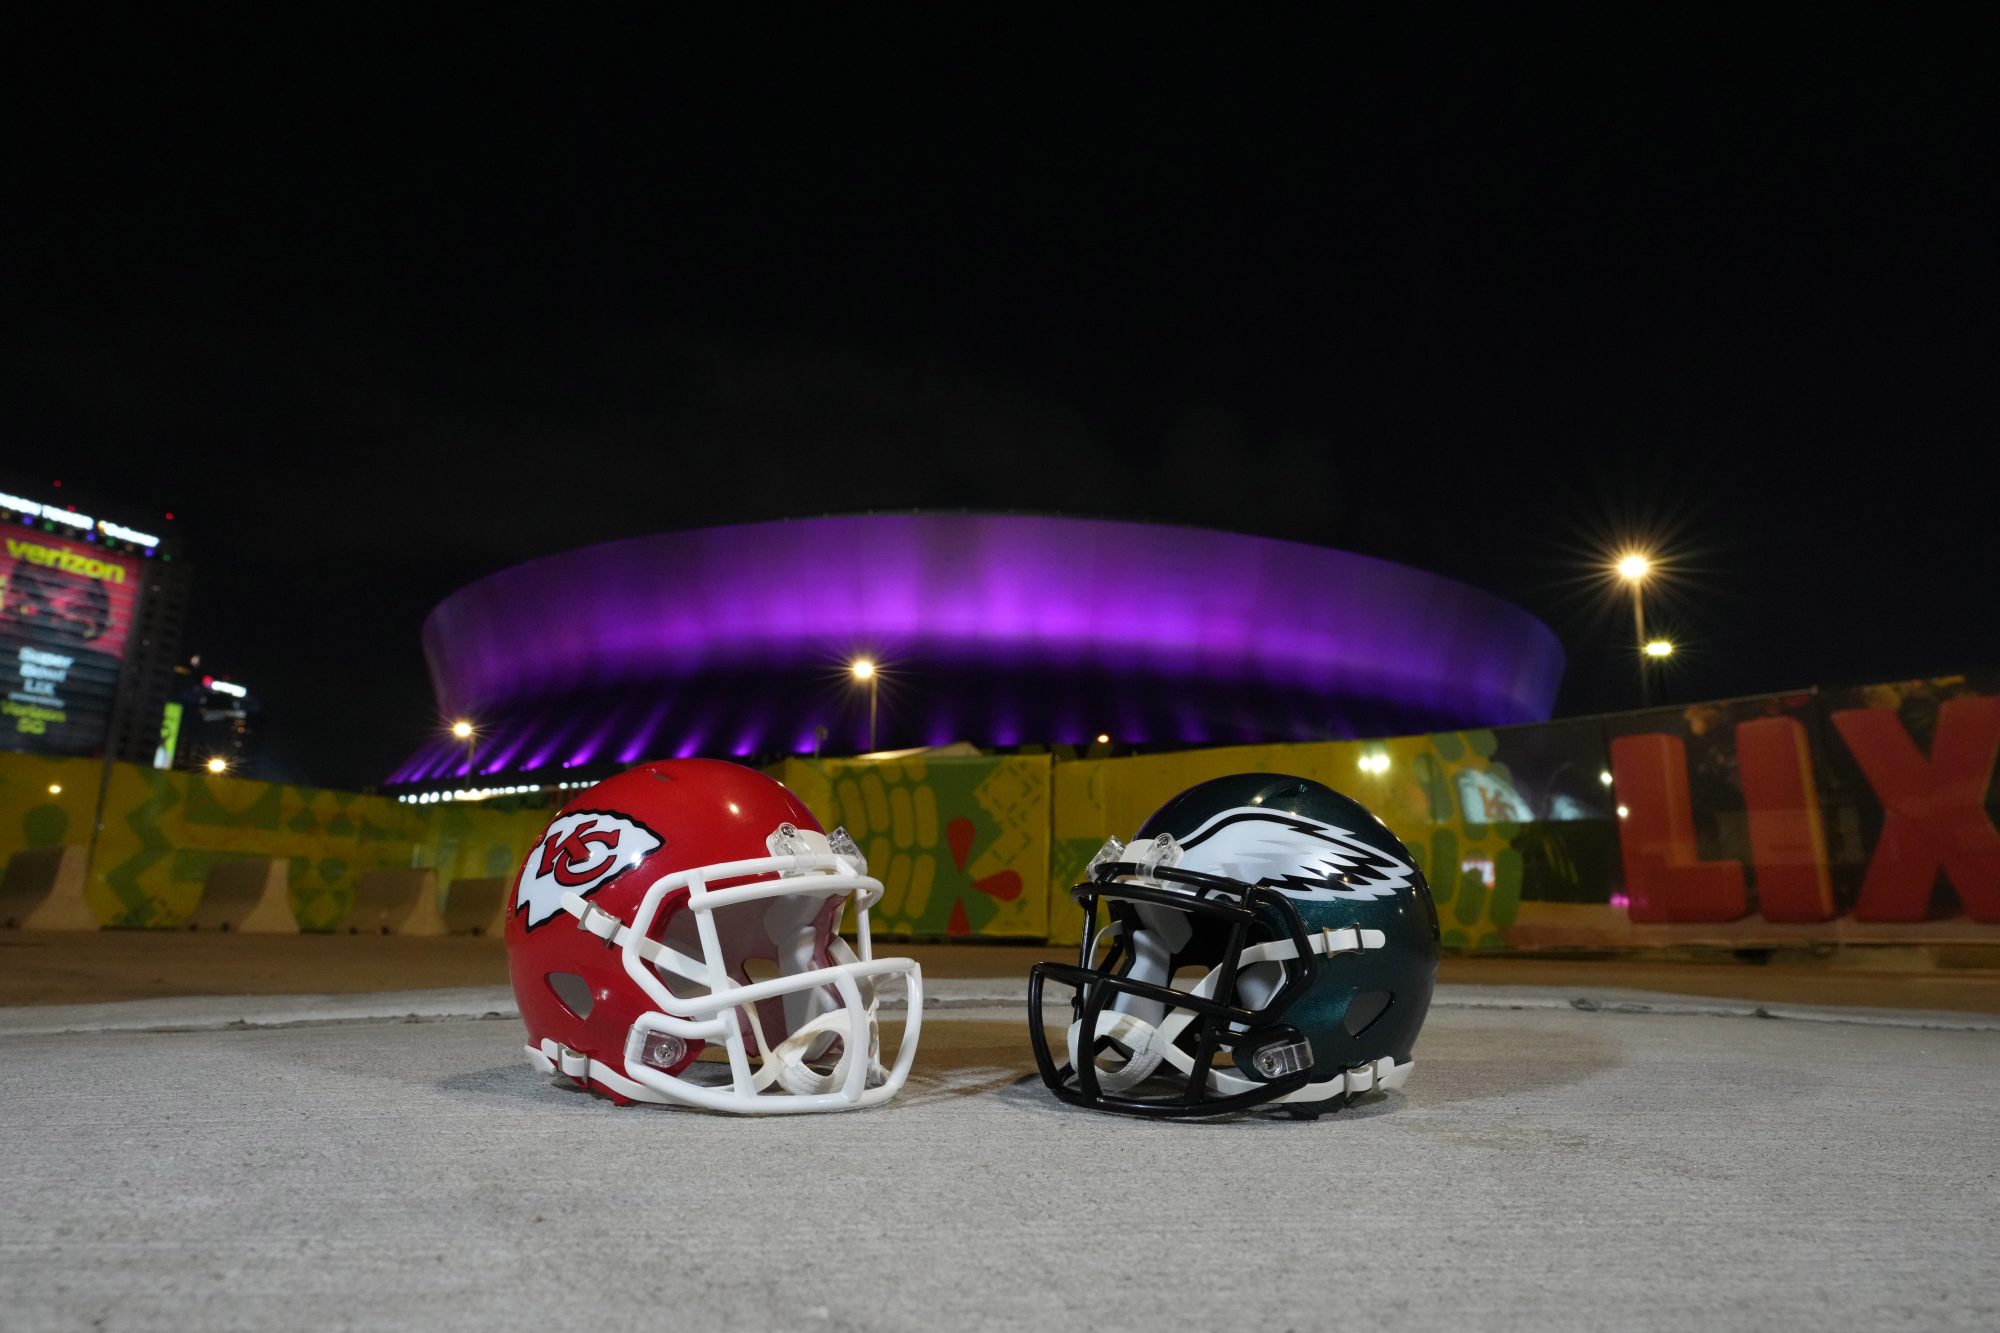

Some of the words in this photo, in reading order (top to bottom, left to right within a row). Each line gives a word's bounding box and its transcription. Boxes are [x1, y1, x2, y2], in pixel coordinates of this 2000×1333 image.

[6, 538, 125, 584] verizon
[1611, 696, 2000, 922] LIX
[536, 819, 621, 887] KC
